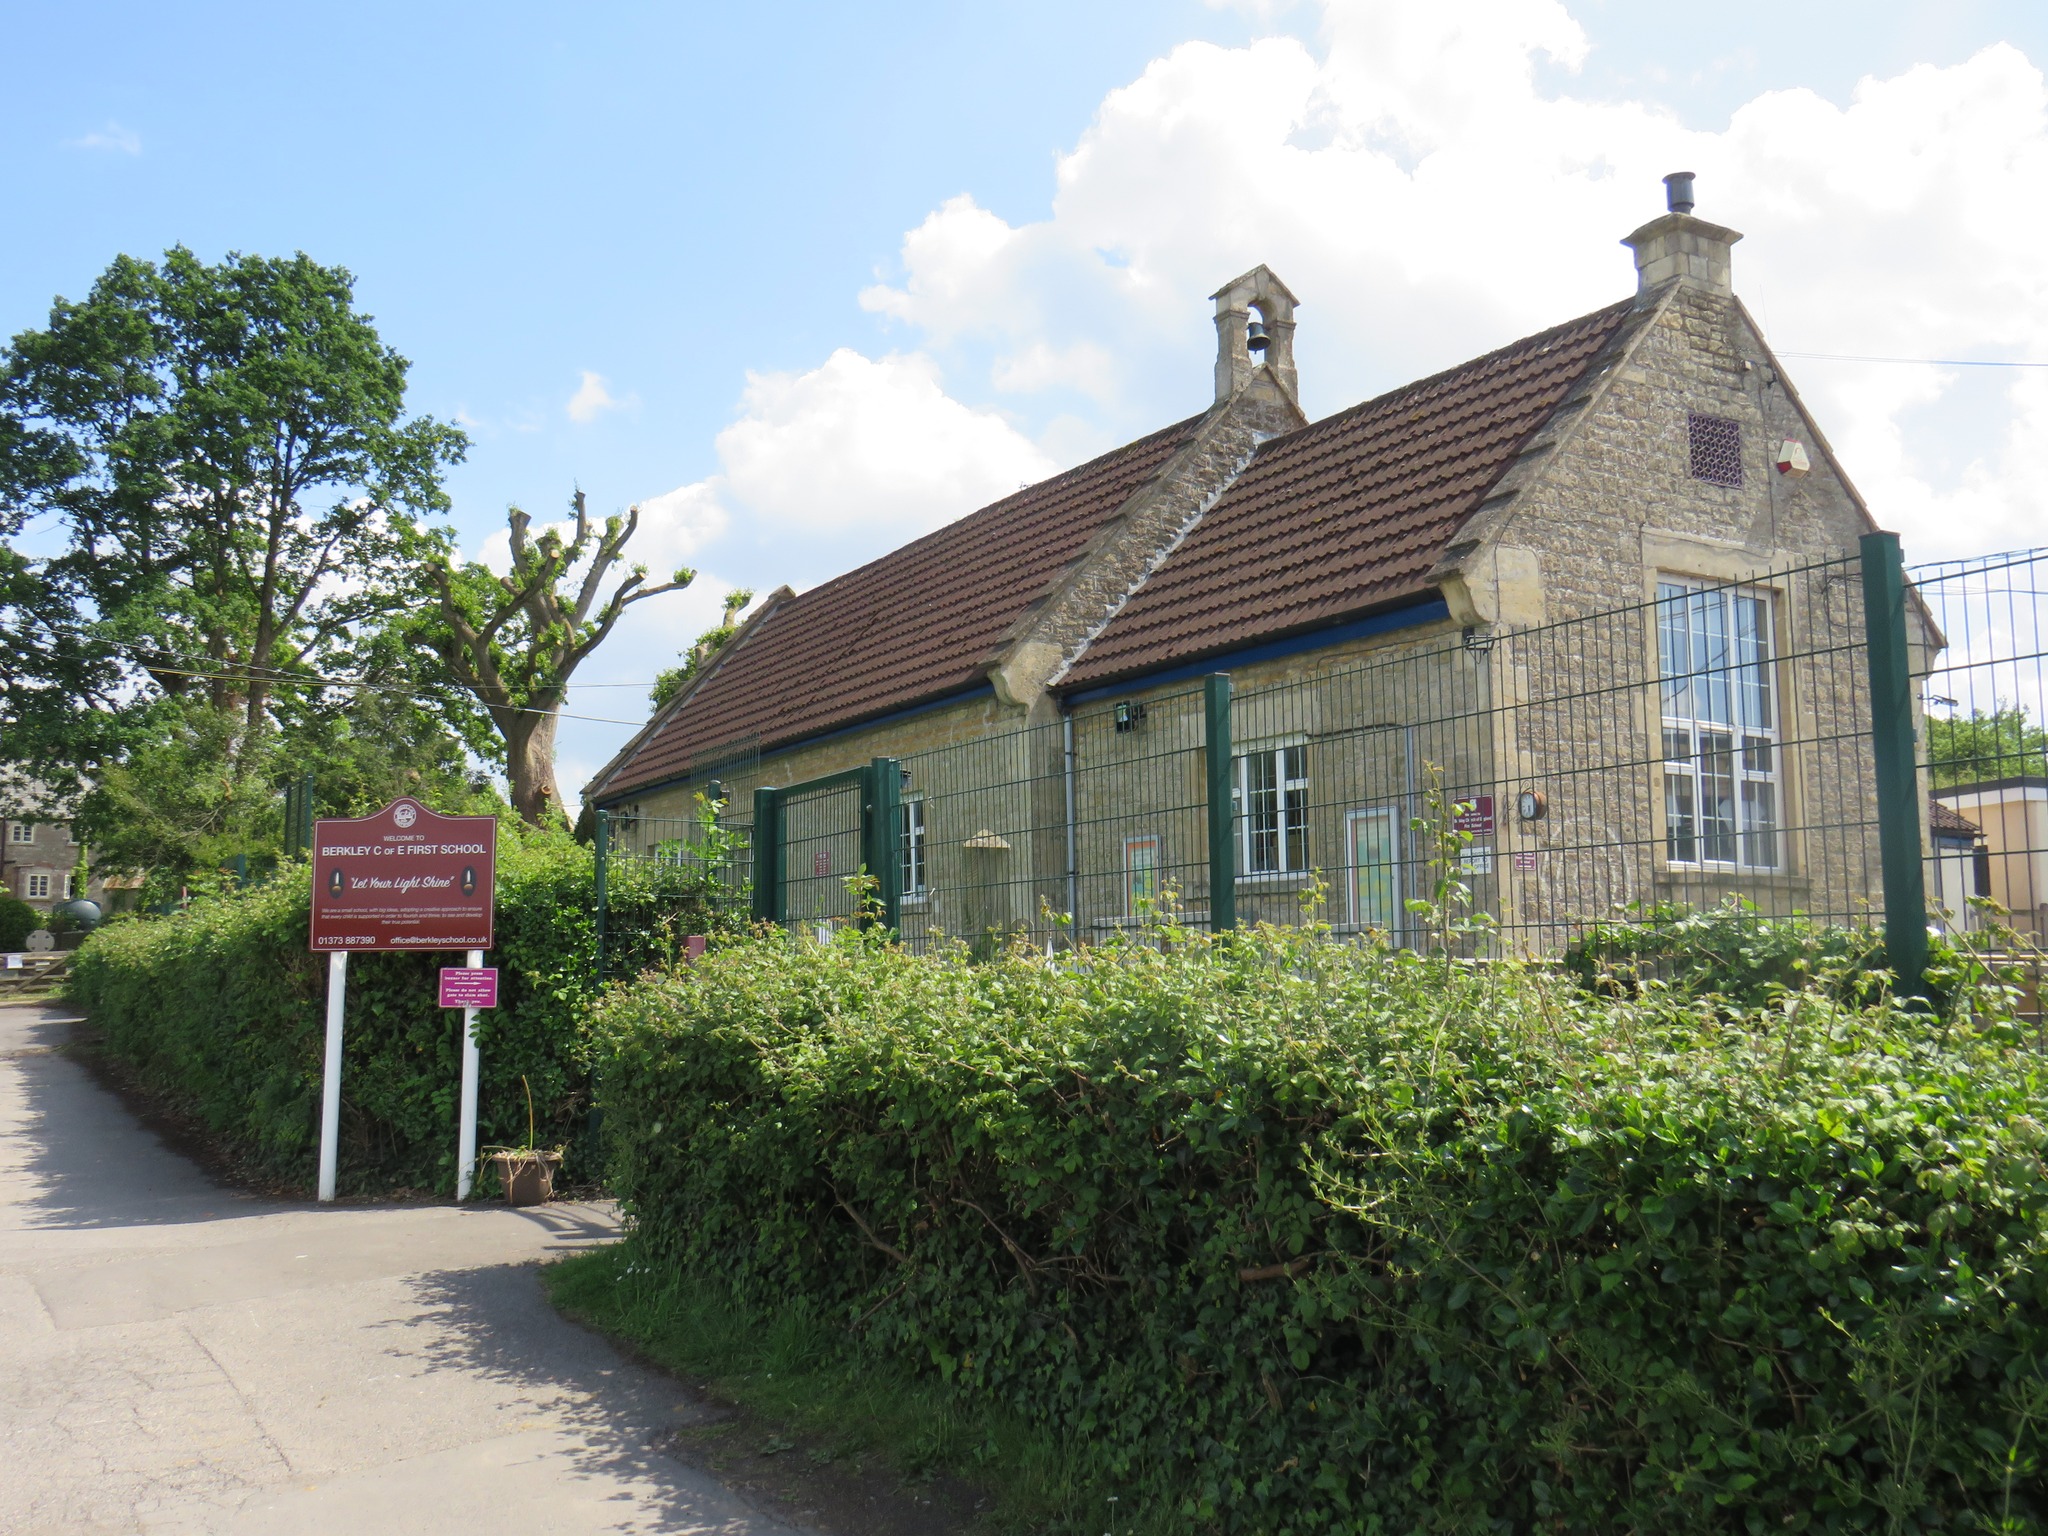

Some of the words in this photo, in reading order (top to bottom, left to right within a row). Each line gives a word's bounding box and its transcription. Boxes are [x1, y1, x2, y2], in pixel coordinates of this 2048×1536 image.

[322, 846, 371, 856] BERKLEY
[373, 846, 382, 855] C
[398, 846, 404, 855] E
[407, 845, 438, 854] FIRST
[440, 844, 486, 854] SCHOOL
[370, 877, 392, 888] Your
[394, 876, 421, 894] Light
[318, 936, 343, 945] 01373
[345, 936, 376, 944] 887390
[390, 936, 487, 946] office@berkleyschool.co.uk
